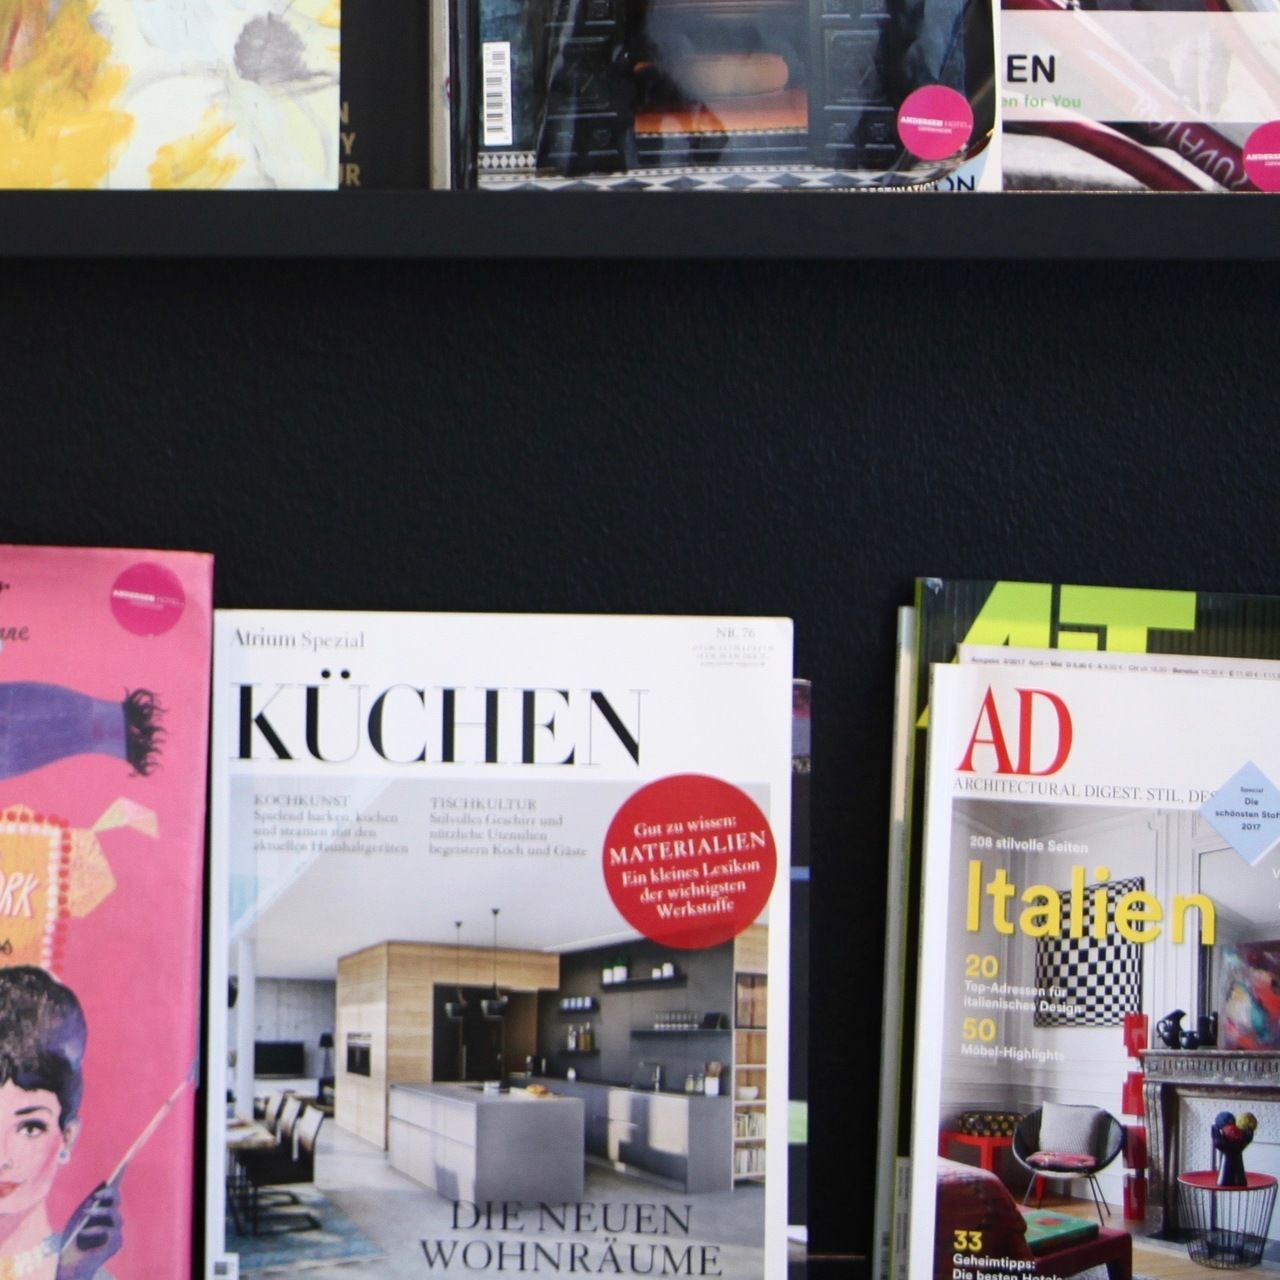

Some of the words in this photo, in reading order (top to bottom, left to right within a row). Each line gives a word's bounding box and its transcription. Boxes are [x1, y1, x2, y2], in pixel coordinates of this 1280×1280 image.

[1007, 54, 1056, 84] EN
[1024, 95, 1046, 108] for
[1052, 95, 1082, 109] You
[231, 627, 296, 648] Atrium
[301, 630, 366, 653] Spezial
[229, 668, 650, 768] KÜCHEN
[954, 683, 1073, 777] AD
[953, 777, 1084, 798] ARCHITECTURAL
[254, 794, 350, 807] KOCHKUNST
[430, 797, 537, 810] TISCHKULTUR
[1244, 797, 1259, 806] Die
[1215, 809, 1260, 819] schönsten
[633, 821, 663, 839] Gut
[666, 822, 684, 836] zu
[687, 815, 737, 833] wissen:
[1241, 823, 1262, 831] 2017
[609, 829, 767, 867] MATERIALIEN
[969, 835, 993, 848] 208
[995, 837, 1044, 851] stilvolle
[1047, 839, 1090, 854] Seiten
[621, 870, 647, 888] Ein
[650, 867, 700, 885] kleines
[702, 858, 761, 879] Lexikon
[640, 887, 663, 904] der
[667, 879, 747, 901] wichtigsten
[966, 859, 1216, 946] Italien
[656, 896, 735, 920] Werkstoffe
[965, 953, 999, 978] 20
[964, 980, 1046, 997] Top-Adressen
[1049, 985, 1069, 998] für
[1040, 1001, 1083, 1016] Design
[962, 1017, 997, 1041] 50
[961, 1043, 1065, 1062] Möbel-Highlights
[451, 1199, 525, 1232] DIE
[537, 1201, 693, 1234] NEUEN
[953, 1229, 983, 1251] 33
[419, 1237, 723, 1276] WOHNRÄUME
[953, 1253, 1037, 1271] Geheimtipps:
[952, 1268, 973, 1280] Die
